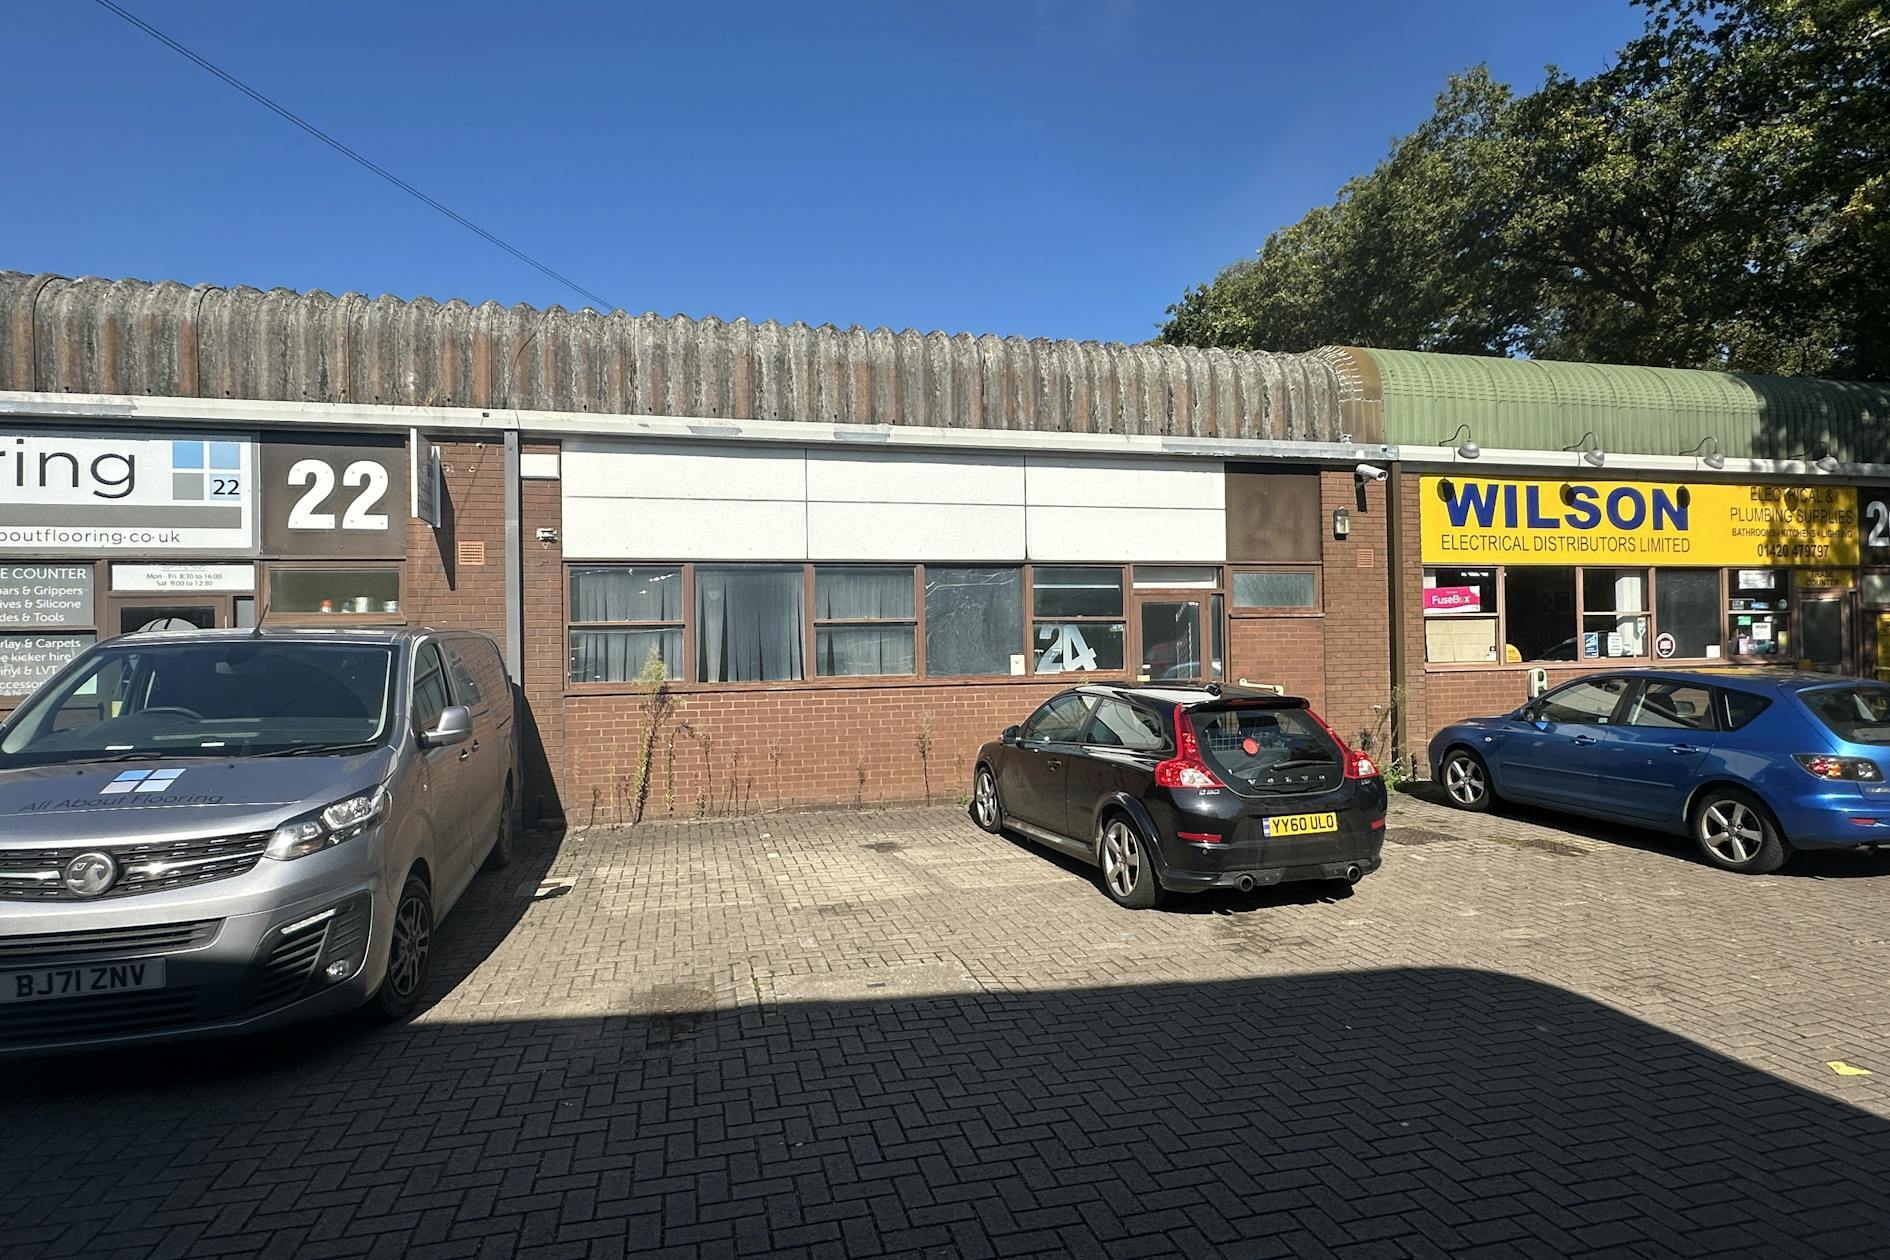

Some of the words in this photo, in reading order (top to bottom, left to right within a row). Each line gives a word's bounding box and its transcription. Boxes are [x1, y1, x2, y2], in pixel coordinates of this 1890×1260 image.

[0, 439, 135, 498] ing
[212, 479, 240, 495] 22
[288, 459, 389, 530] 22
[1750, 487, 1823, 503] ELECTRICAL
[1825, 487, 1835, 503] &
[1440, 482, 1689, 530] WILSON
[1730, 507, 1793, 523] PLUMBING
[1796, 509, 1854, 524] SUPPLIES
[1866, 501, 1890, 547] 2
[1732, 528, 1776, 537] BATHROOMS
[1781, 528, 1816, 537] KITCHENS
[1822, 529, 1853, 538] LIGHTING
[1441, 534, 1529, 551] ELECTRICAL
[1533, 535, 1636, 552] DISTRIBUTORS
[1640, 536, 1690, 553] LIMITED
[1757, 544, 1789, 557] 01420
[1792, 544, 1830, 557] 479797
[12, 567, 87, 579] COUNTER
[22, 586, 31, 595] &
[33, 586, 84, 597] Grippers
[24, 599, 33, 609] &
[36, 599, 82, 609] Silicone
[22, 612, 31, 622] &
[33, 612, 65, 622] Tools
[24, 639, 33, 649] &
[36, 638, 82, 650] Carpets
[1036, 624, 1097, 674] 24
[11, 652, 46, 662] kicker
[49, 652, 72, 661] hire
[24, 666, 33, 675] &
[36, 665, 58, 675] LVT
[19, 801, 51, 812] All
[55, 796, 125, 808] About
[131, 794, 224, 804] Flooring
[1271, 816, 1307, 834] YY60
[1311, 814, 1334, 830] ULO
[16, 970, 82, 998] BJ71
[90, 963, 146, 990] ZNV
